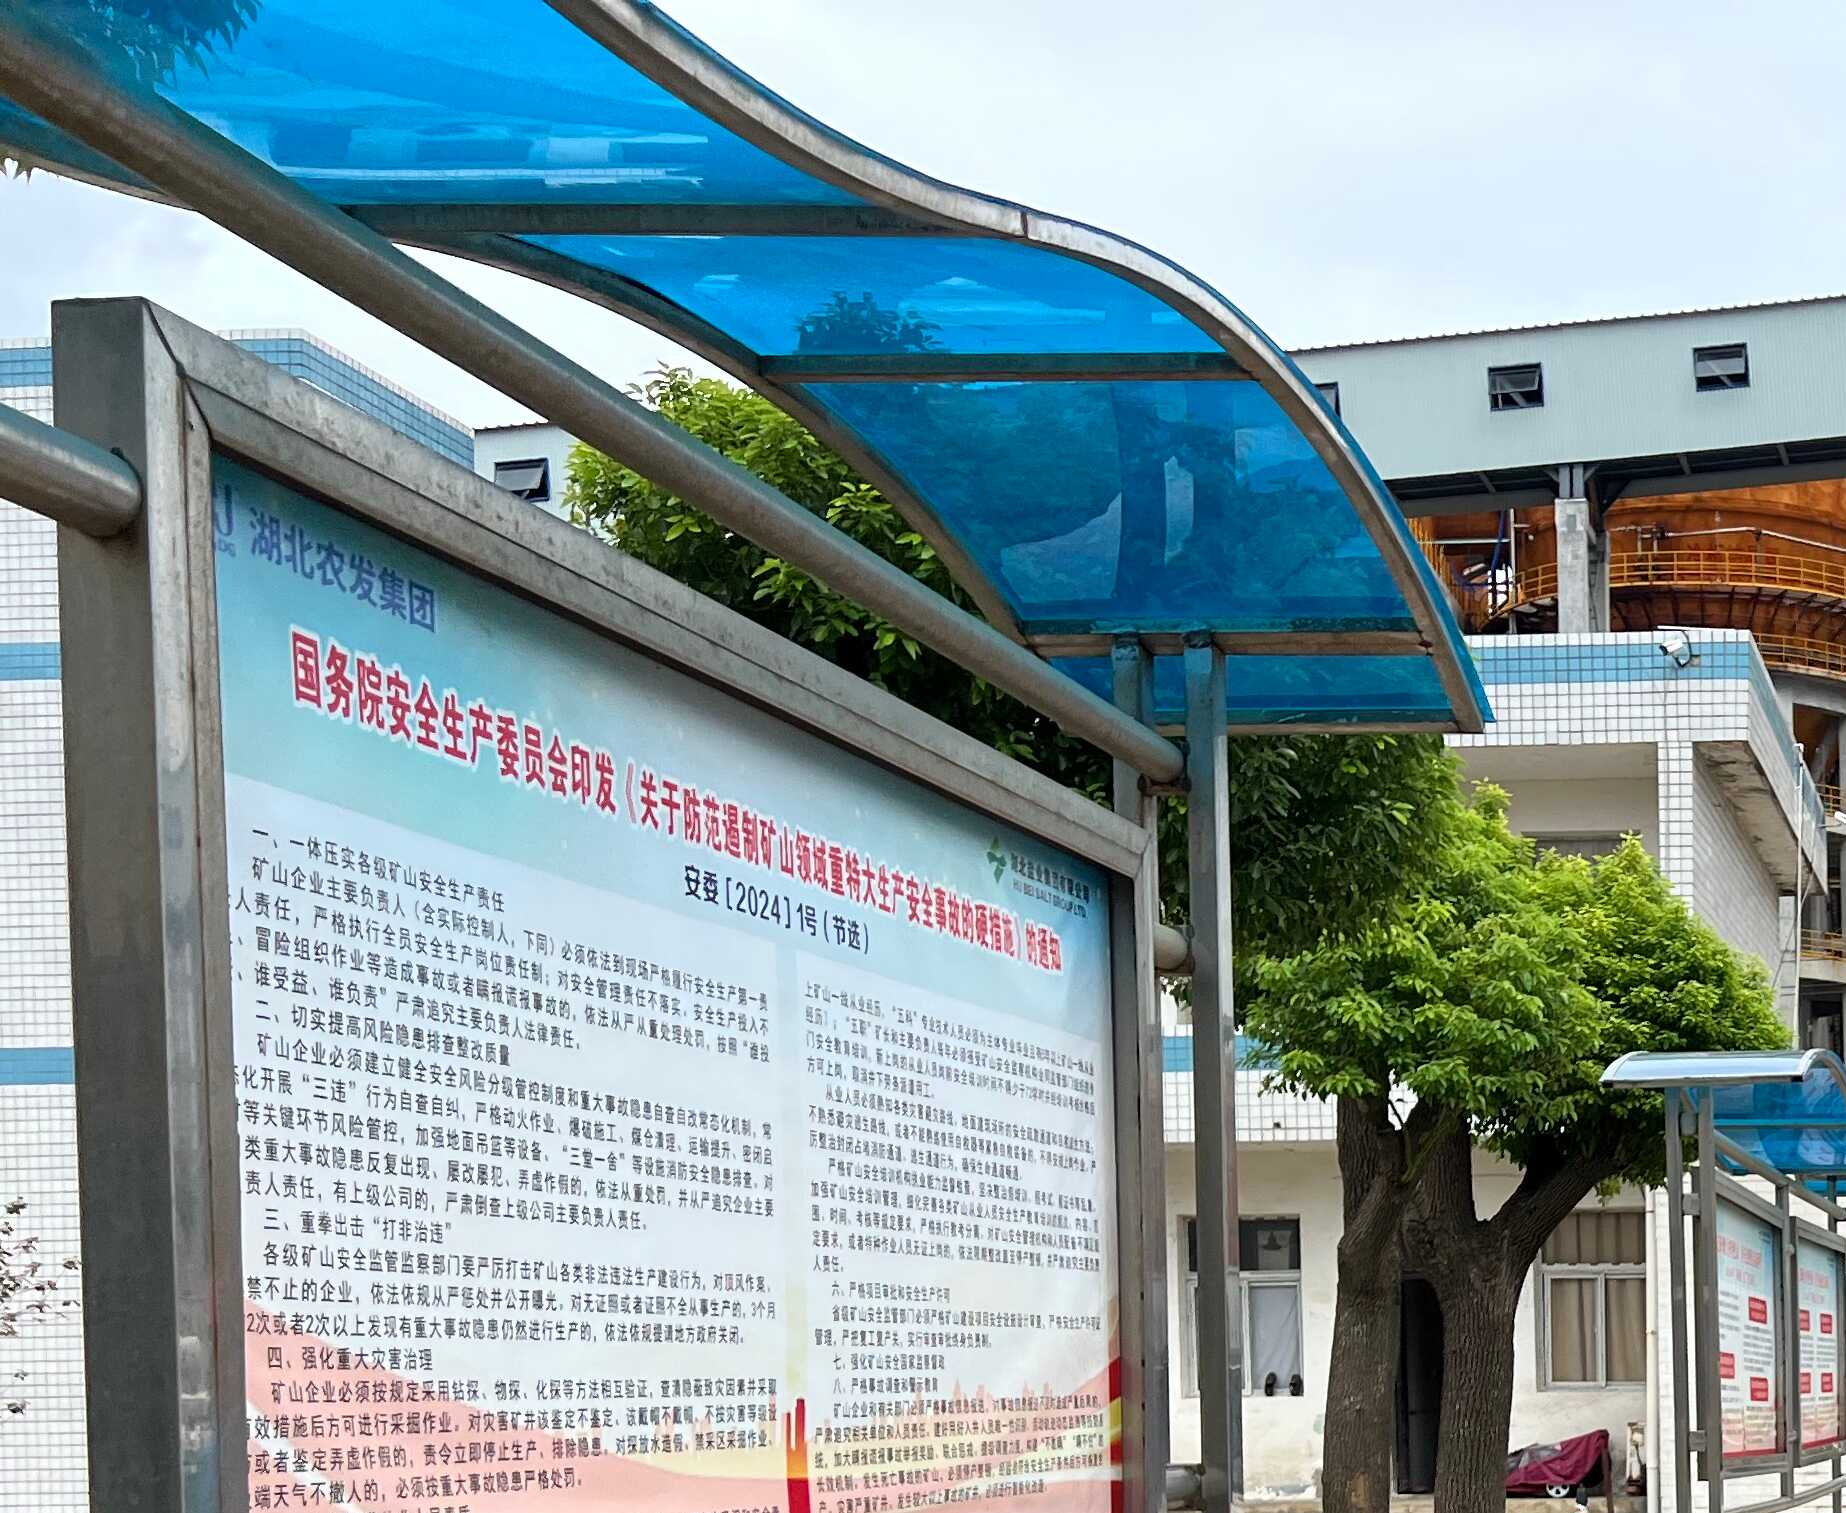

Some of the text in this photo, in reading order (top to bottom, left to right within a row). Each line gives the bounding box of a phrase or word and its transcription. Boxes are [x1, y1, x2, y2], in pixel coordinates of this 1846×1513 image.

[250, 506, 436, 634] 湖北农发集团
[246, 1466, 582, 1512] 端天气不撤人的，必须按重大事故隐患严格处罚。
